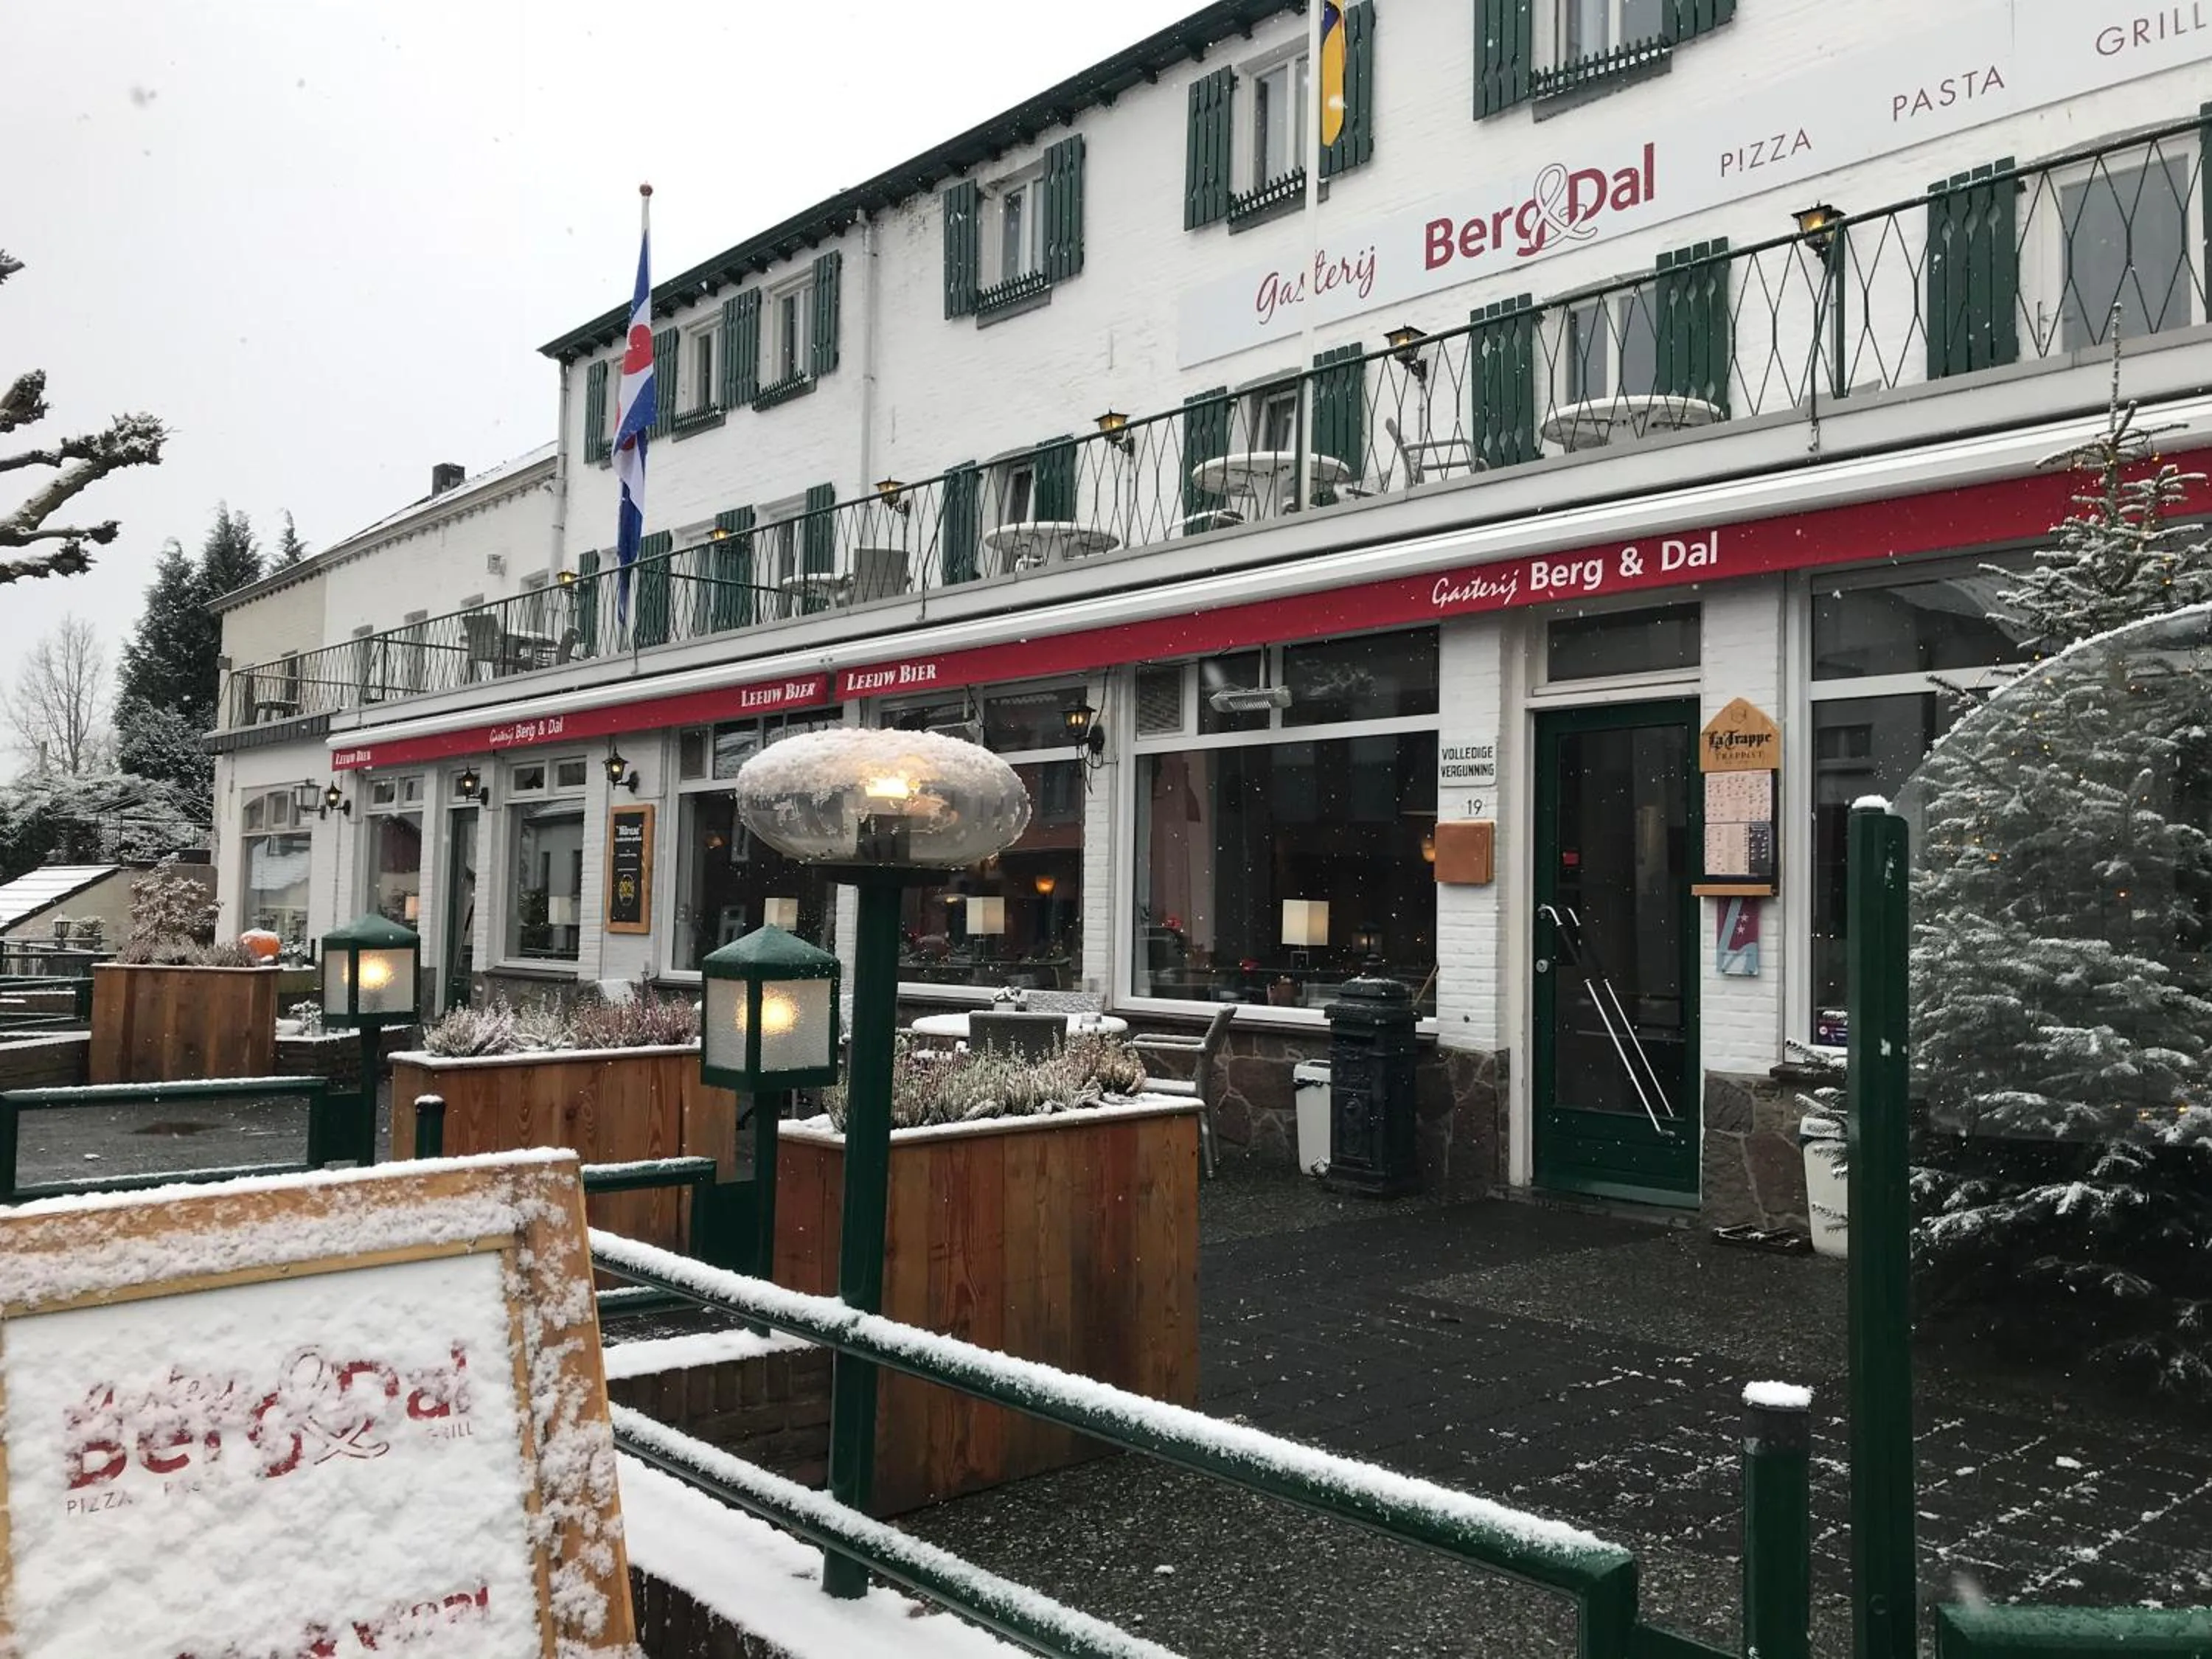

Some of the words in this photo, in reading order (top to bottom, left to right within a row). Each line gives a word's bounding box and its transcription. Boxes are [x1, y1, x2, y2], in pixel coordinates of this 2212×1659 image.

[1720, 128, 1812, 178] PIZZA
[1892, 65, 2006, 122] PASTA
[2096, 2, 2207, 55] GRILL
[1425, 198, 1545, 271] Berg
[1529, 163, 1598, 249] &
[1568, 142, 1655, 226] Dal
[1432, 568, 1520, 608] Gasterij
[1530, 557, 1603, 591] Berg
[1619, 546, 1644, 577] &
[1661, 530, 1719, 572] Dal
[1724, 728, 1772, 750] Trappe
[1441, 746, 1493, 760] VOLLEDIGE
[1440, 763, 1495, 778] VERGUNNING
[1467, 799, 1483, 815] 19
